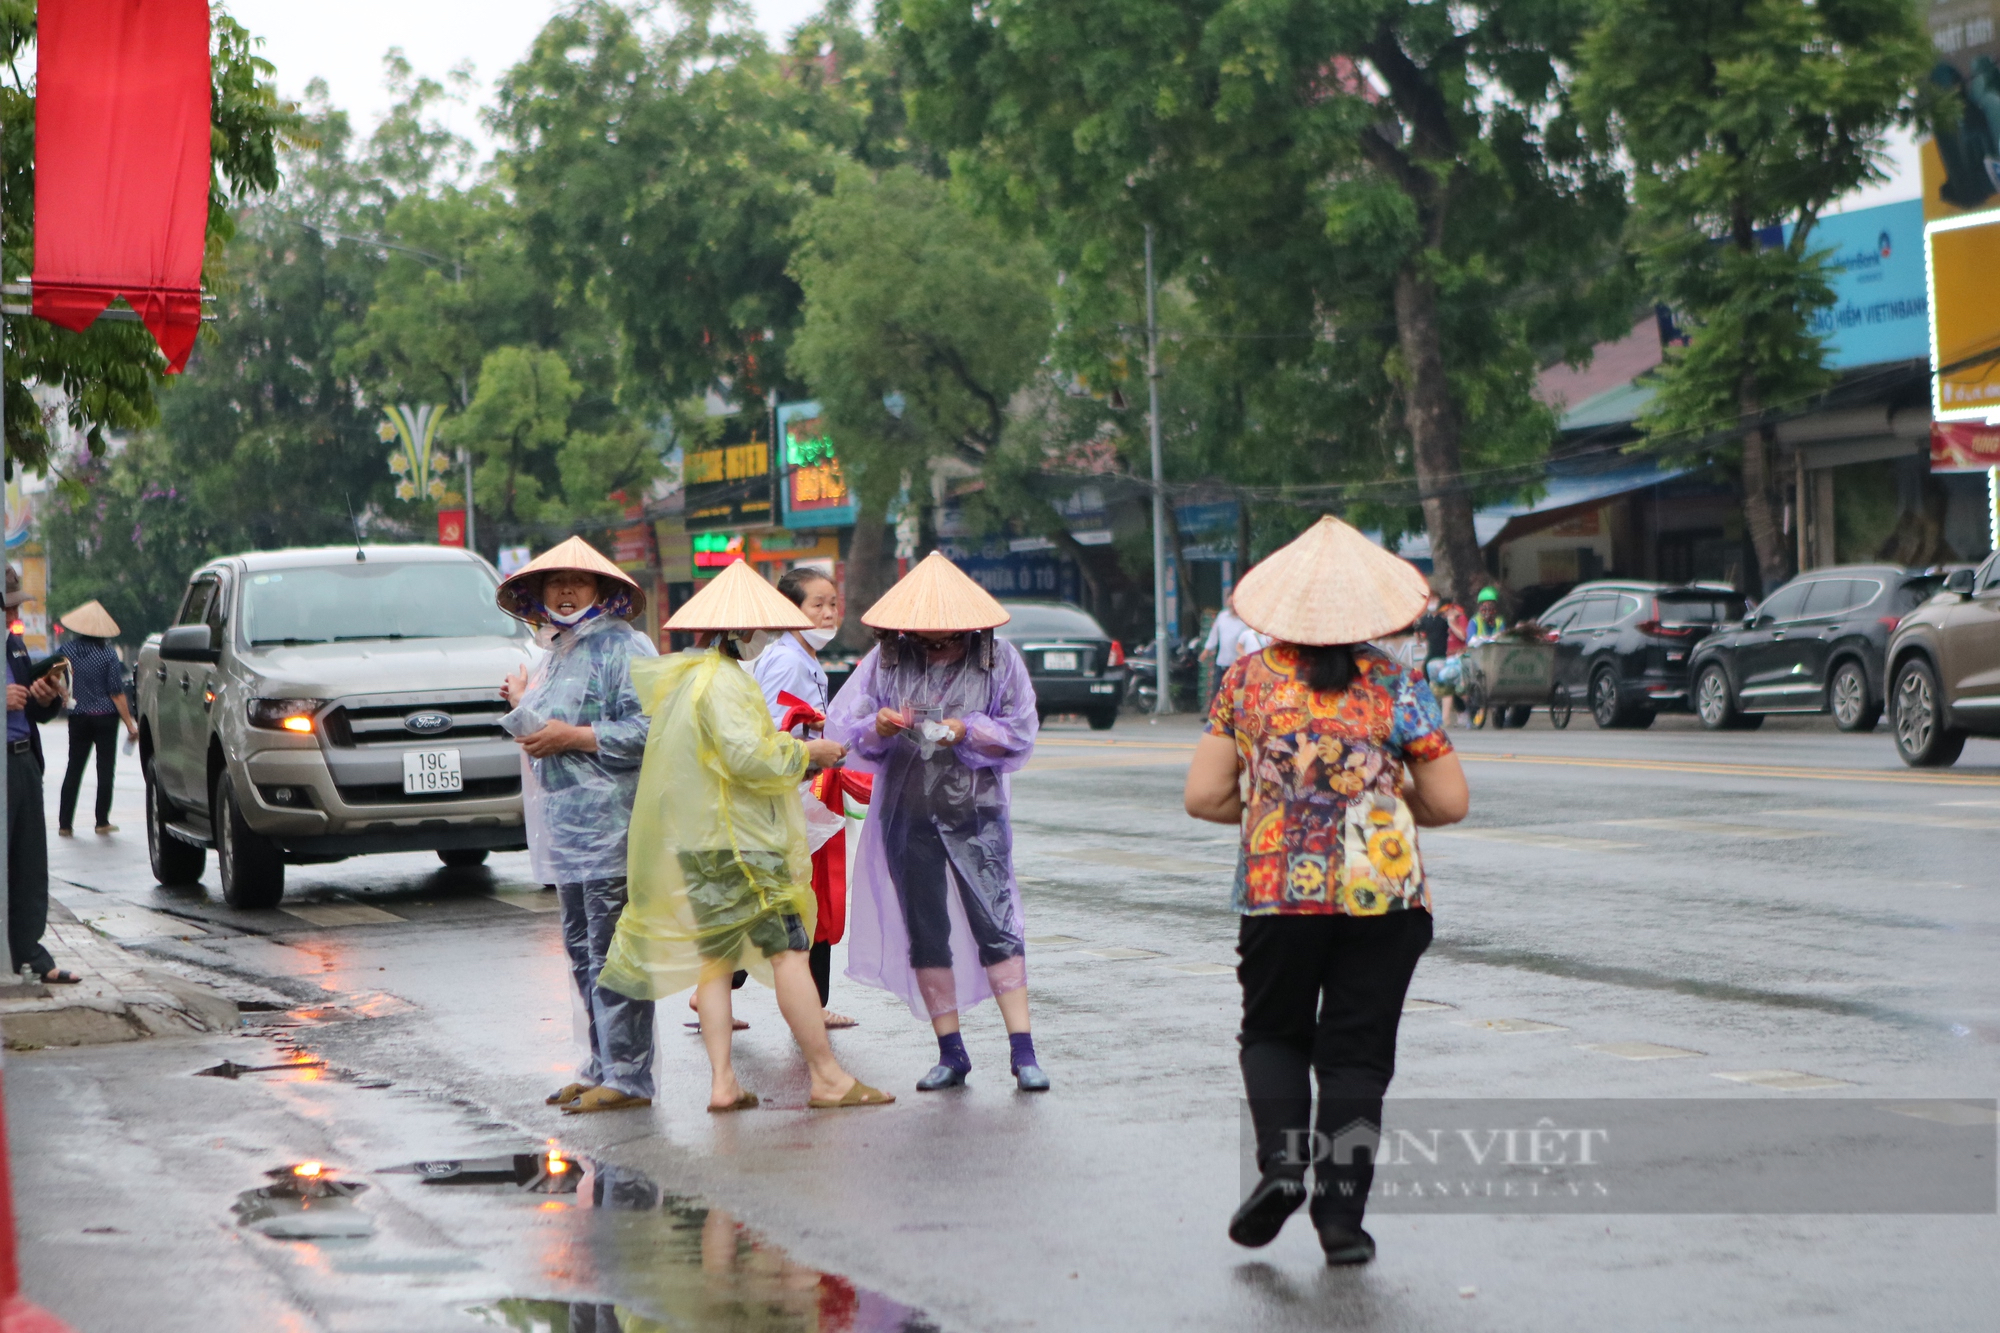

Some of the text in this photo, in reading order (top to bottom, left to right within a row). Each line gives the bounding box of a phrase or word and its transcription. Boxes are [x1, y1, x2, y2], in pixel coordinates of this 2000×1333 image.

[415, 715, 442, 729] Ford
[418, 752, 448, 771] 19C
[408, 770, 460, 791] 119.55
